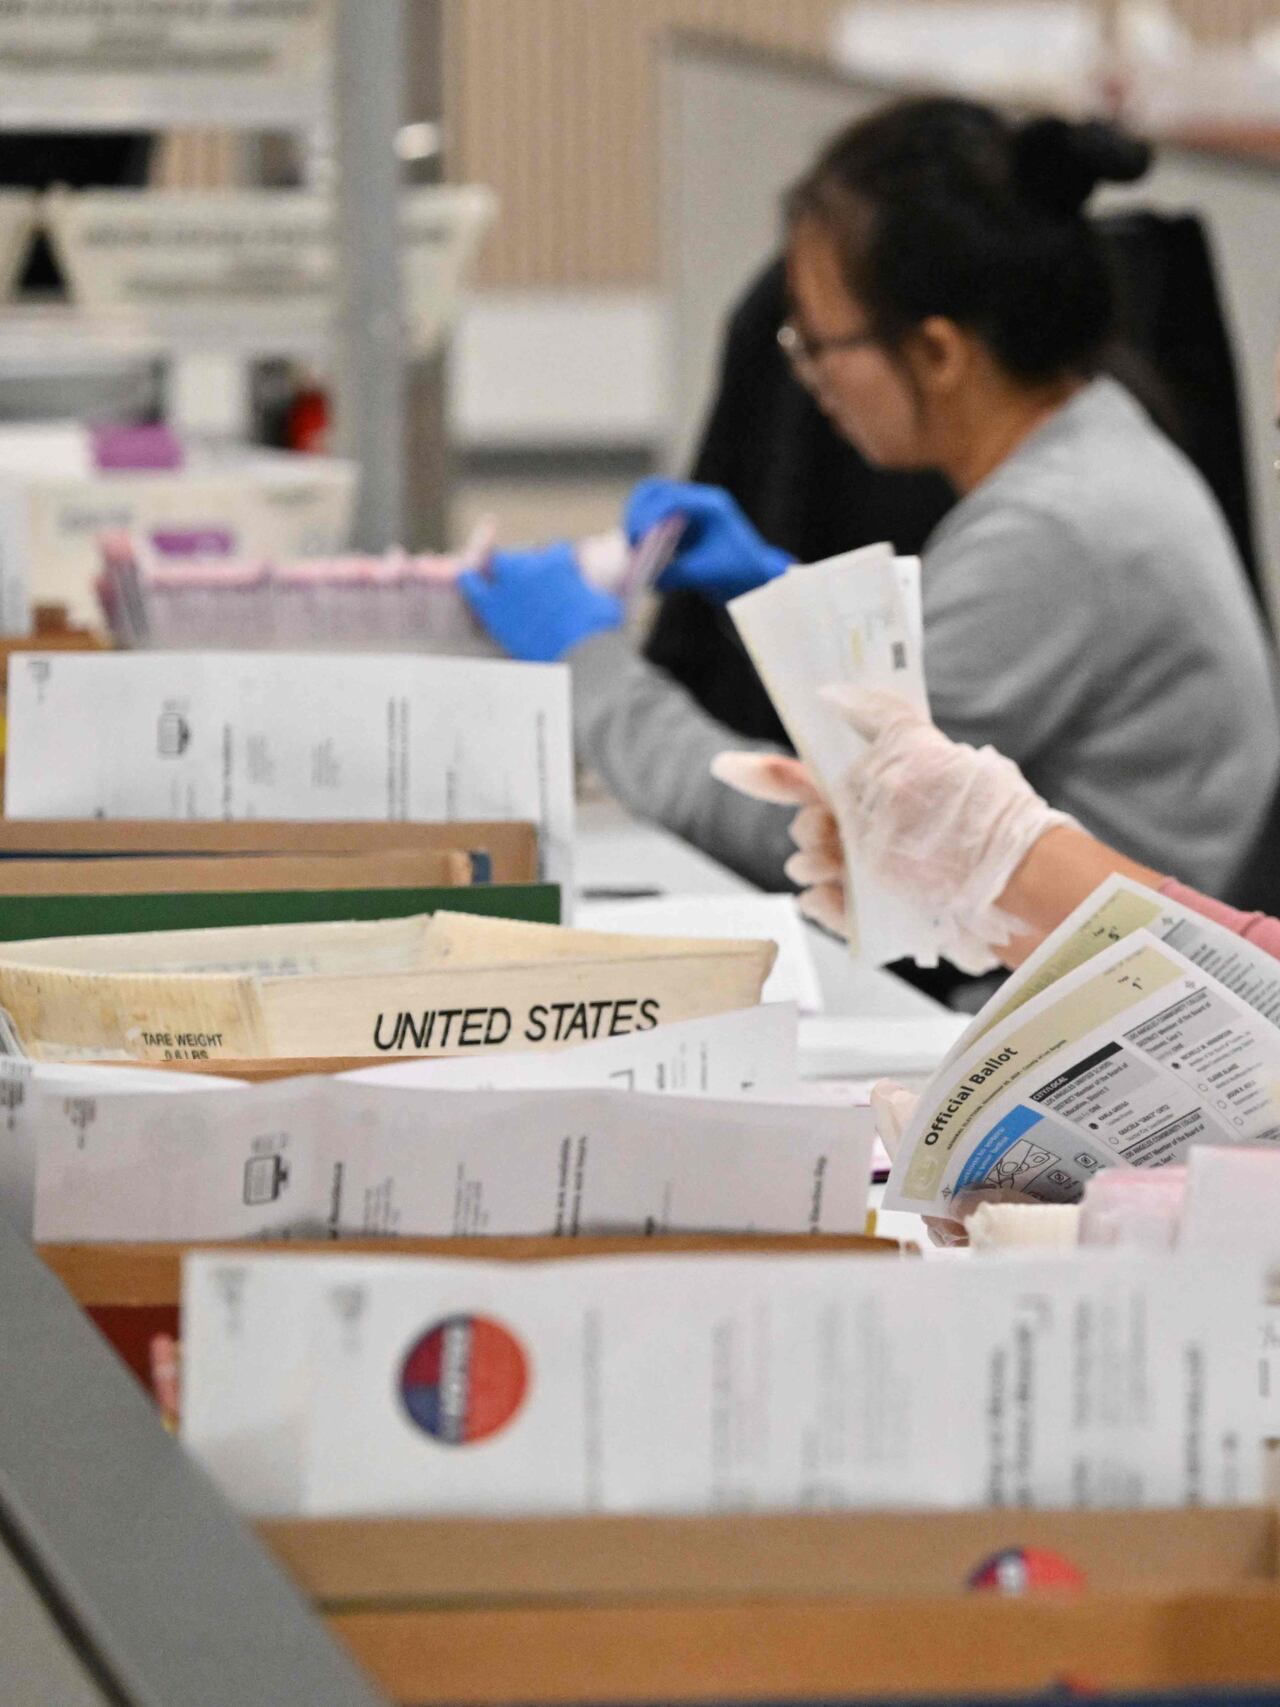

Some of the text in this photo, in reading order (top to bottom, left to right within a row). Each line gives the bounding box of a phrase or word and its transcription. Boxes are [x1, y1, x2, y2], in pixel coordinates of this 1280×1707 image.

[142, 1033, 222, 1047] TARE WEIGHT
[374, 999, 660, 1051] UNITED STATES
[925, 1085, 974, 1146] Official
[969, 1047, 1018, 1086] Ballot
[1032, 1075, 1068, 1100] CITY/LOCAL
[1053, 1082, 1076, 1100] ANGELES
[1053, 1094, 1076, 1112] DISTRICT
[1074, 1082, 1096, 1098] Member
[1131, 1151, 1154, 1168] DISTRICT
[1152, 1141, 1172, 1156] Member
[1183, 1125, 1199, 1138] Board
[1132, 1139, 1153, 1154] ANGELES
[1152, 1122, 1182, 1143] COMMUNITY
